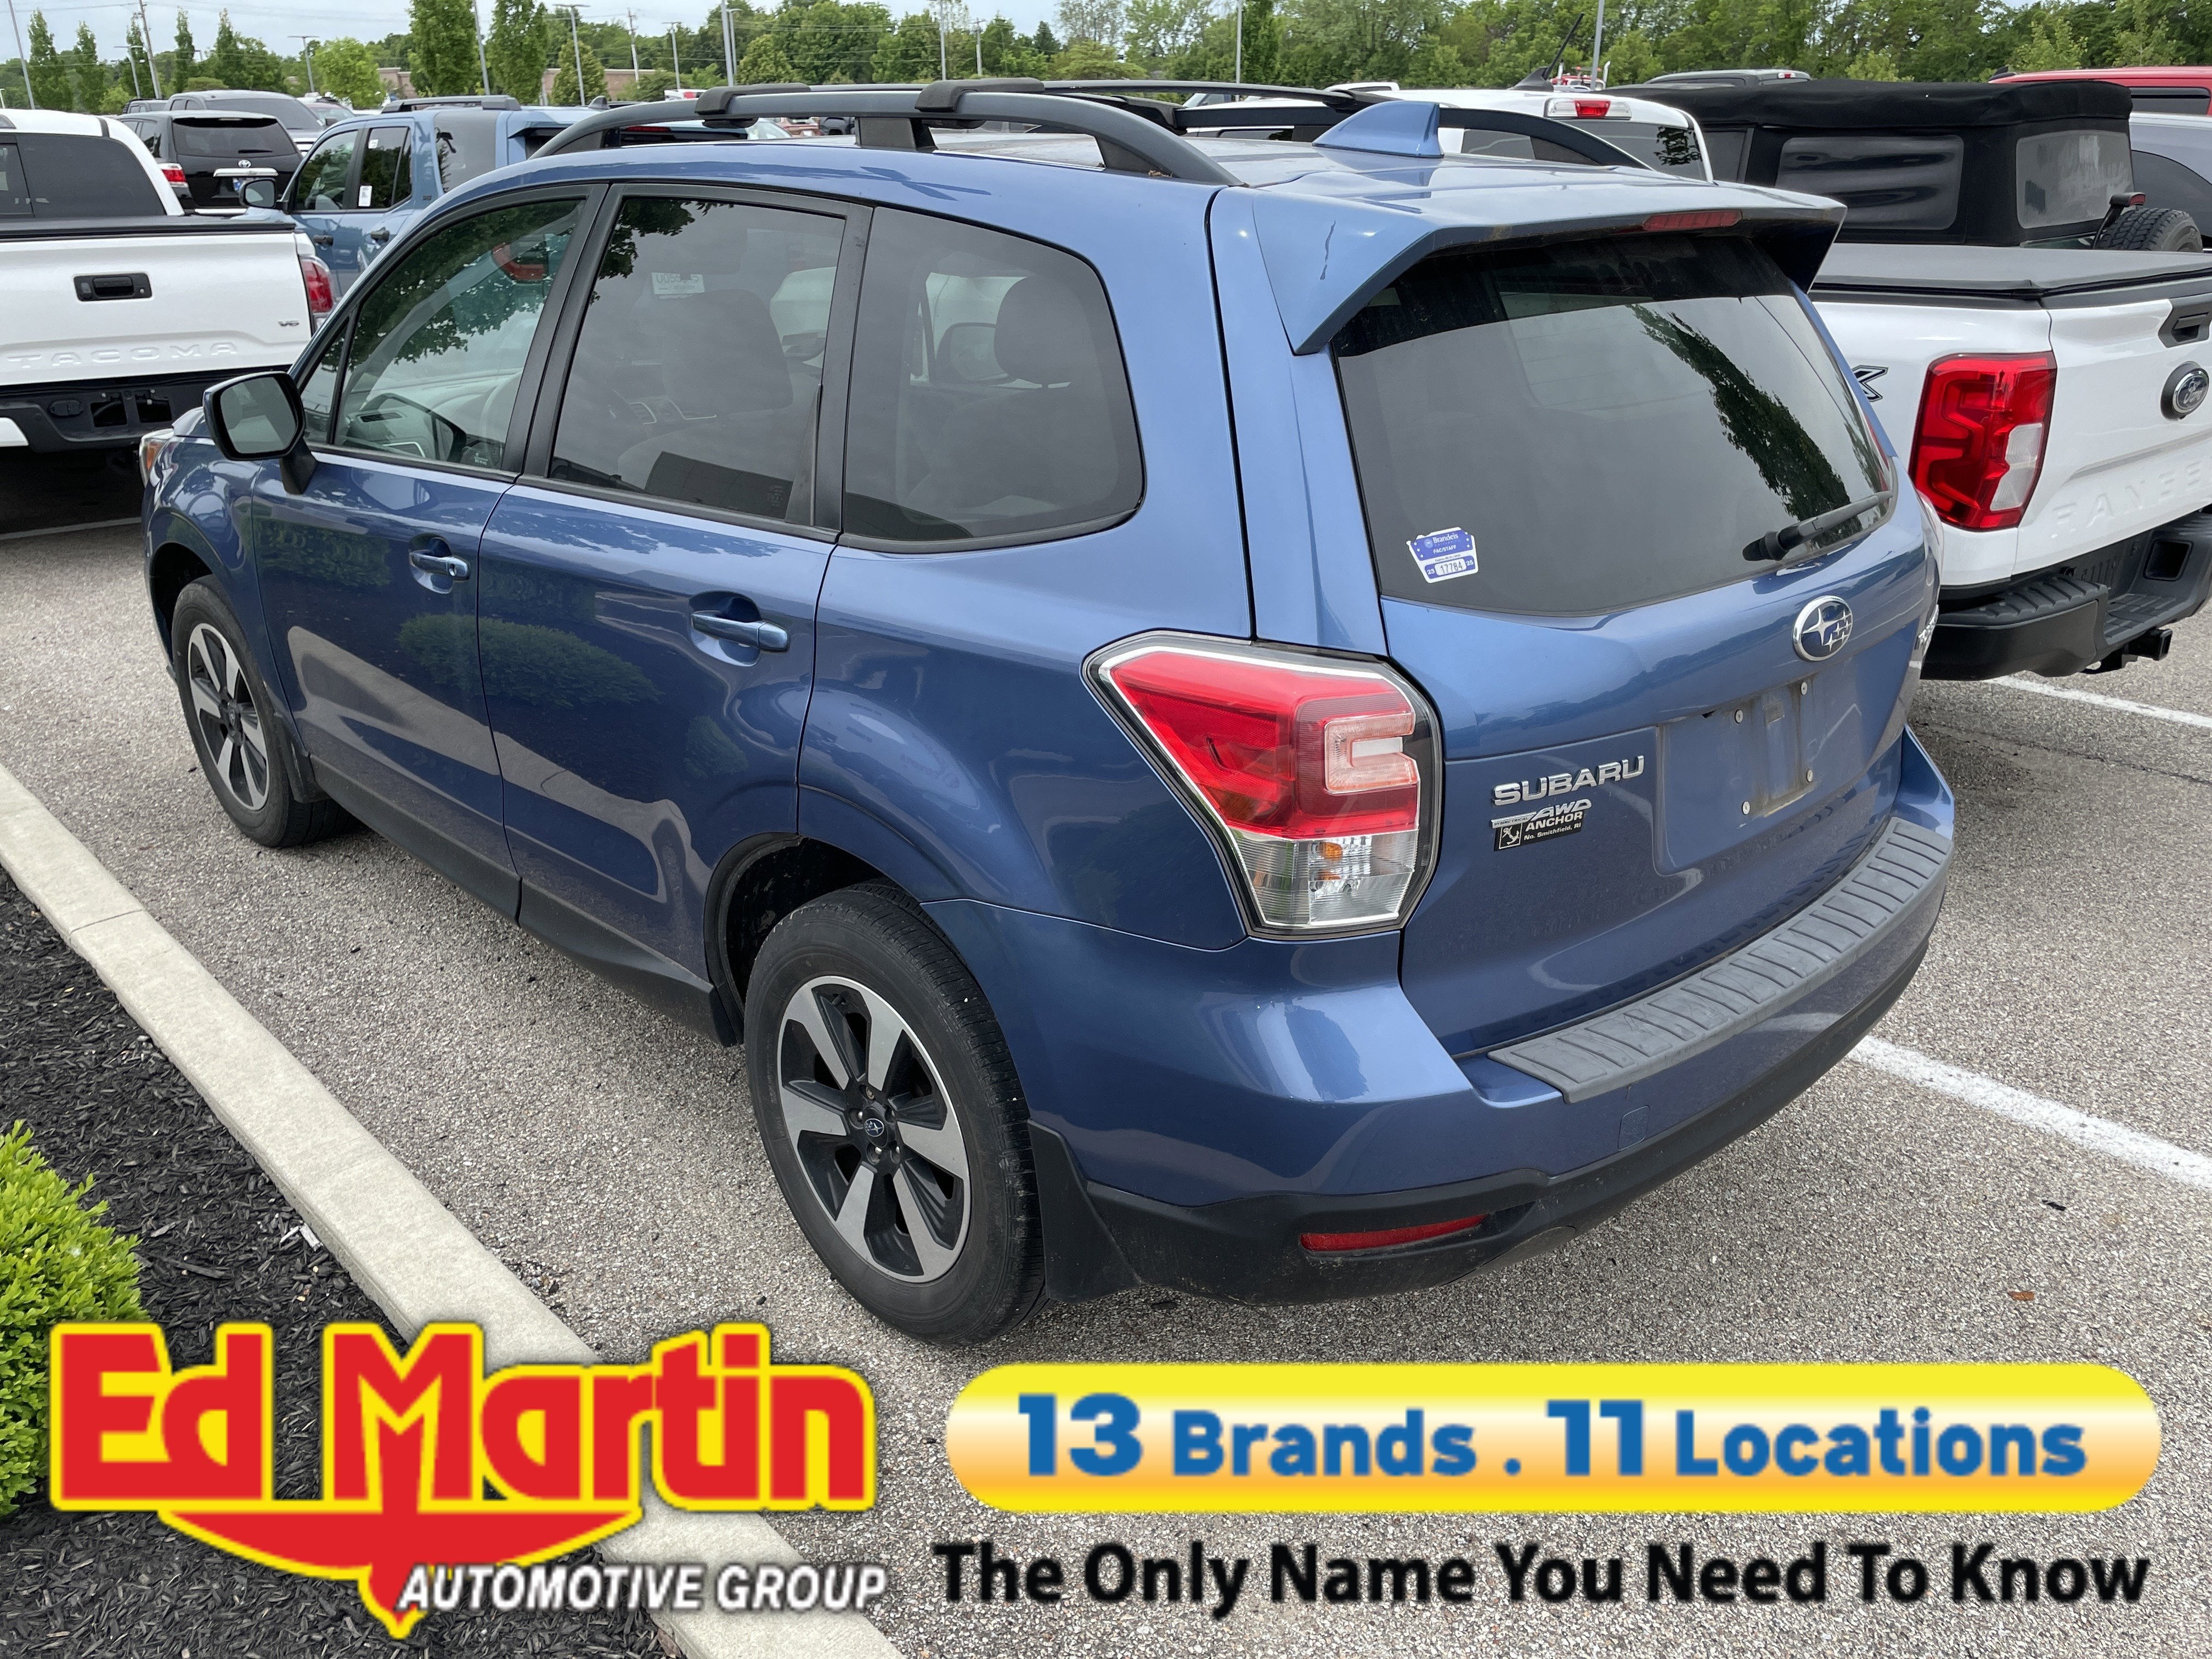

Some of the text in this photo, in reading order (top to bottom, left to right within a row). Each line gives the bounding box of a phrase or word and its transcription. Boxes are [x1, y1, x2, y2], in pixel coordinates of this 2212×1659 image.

[7, 341, 238, 368] TACOMA
[2050, 456, 2212, 539] RANGE
[1432, 532, 1459, 543] Brandeis
[1433, 545, 1457, 554] FAC/STAFF
[1441, 561, 1463, 573] 17784
[1492, 755, 1645, 806] SUBARU
[1530, 799, 1592, 821] AWD
[1525, 811, 1583, 832] ANCHOR
